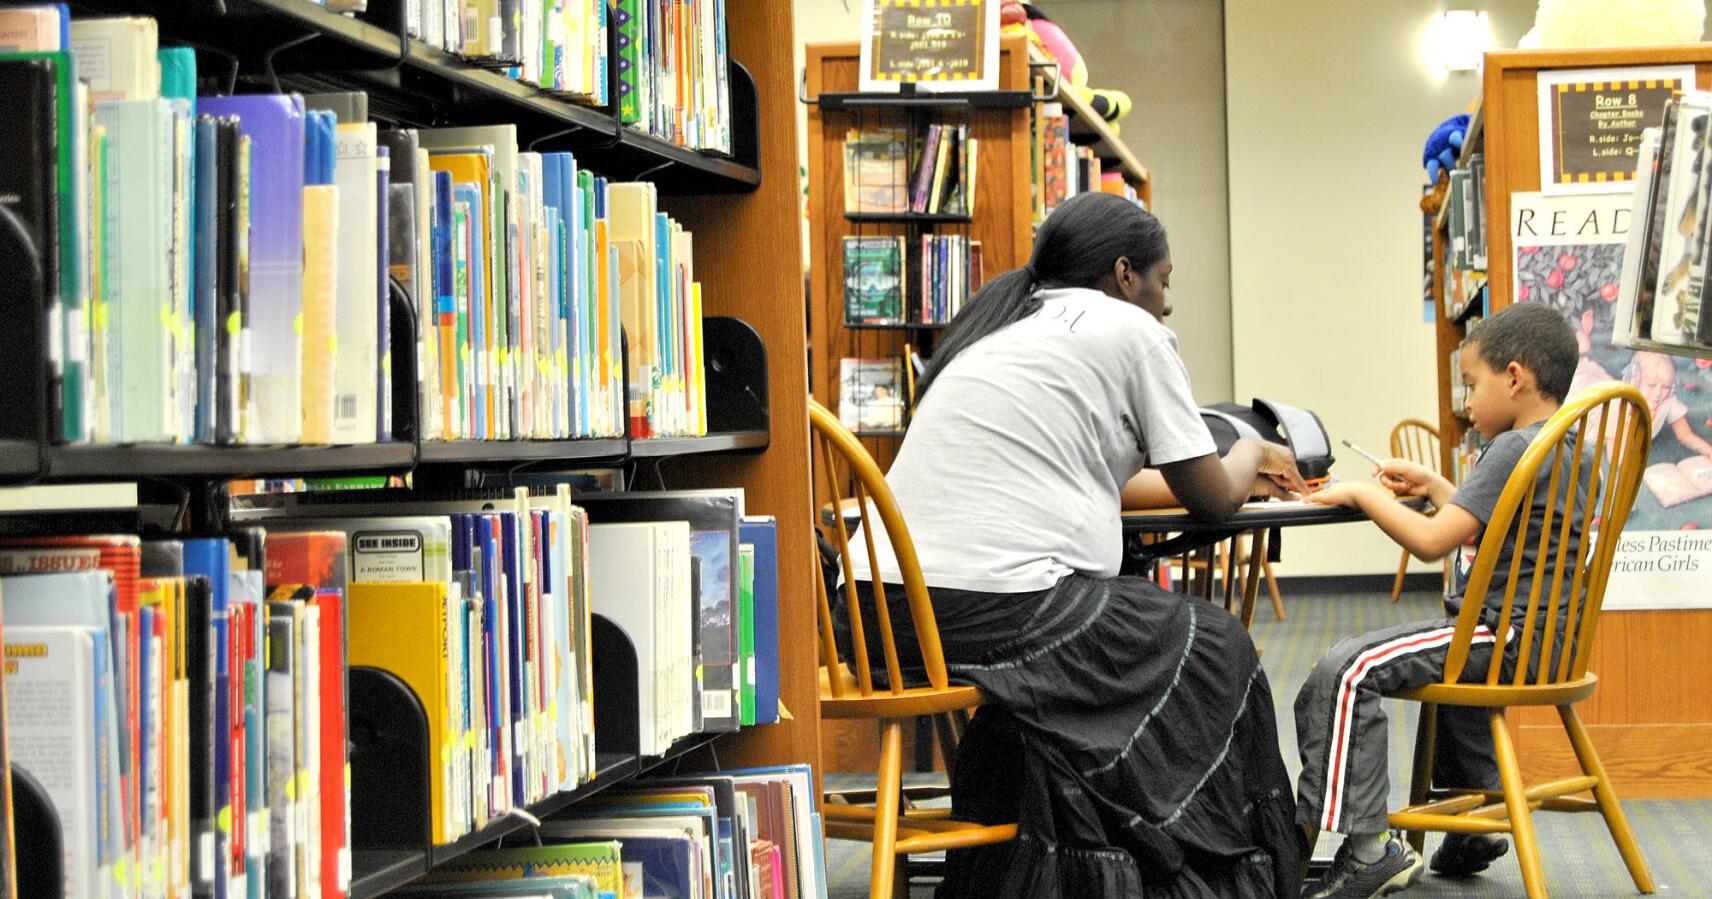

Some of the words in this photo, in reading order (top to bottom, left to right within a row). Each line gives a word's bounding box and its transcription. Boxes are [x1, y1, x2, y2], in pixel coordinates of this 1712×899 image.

[907, 14, 931, 26] Row
[1595, 94, 1622, 107] Row
[1628, 93, 1637, 106] 8
[1590, 110, 1619, 120] Chapter
[1622, 109, 1644, 119] Books
[1598, 120, 1608, 129] By
[1610, 119, 1637, 129] Author
[1593, 148, 1622, 157] L.side:
[1516, 208, 1632, 237] READ
[359, 538, 378, 549] SEE
[381, 538, 416, 548] INSIDE
[396, 565, 417, 573] TOWN
[1657, 555, 1699, 573] Girls
